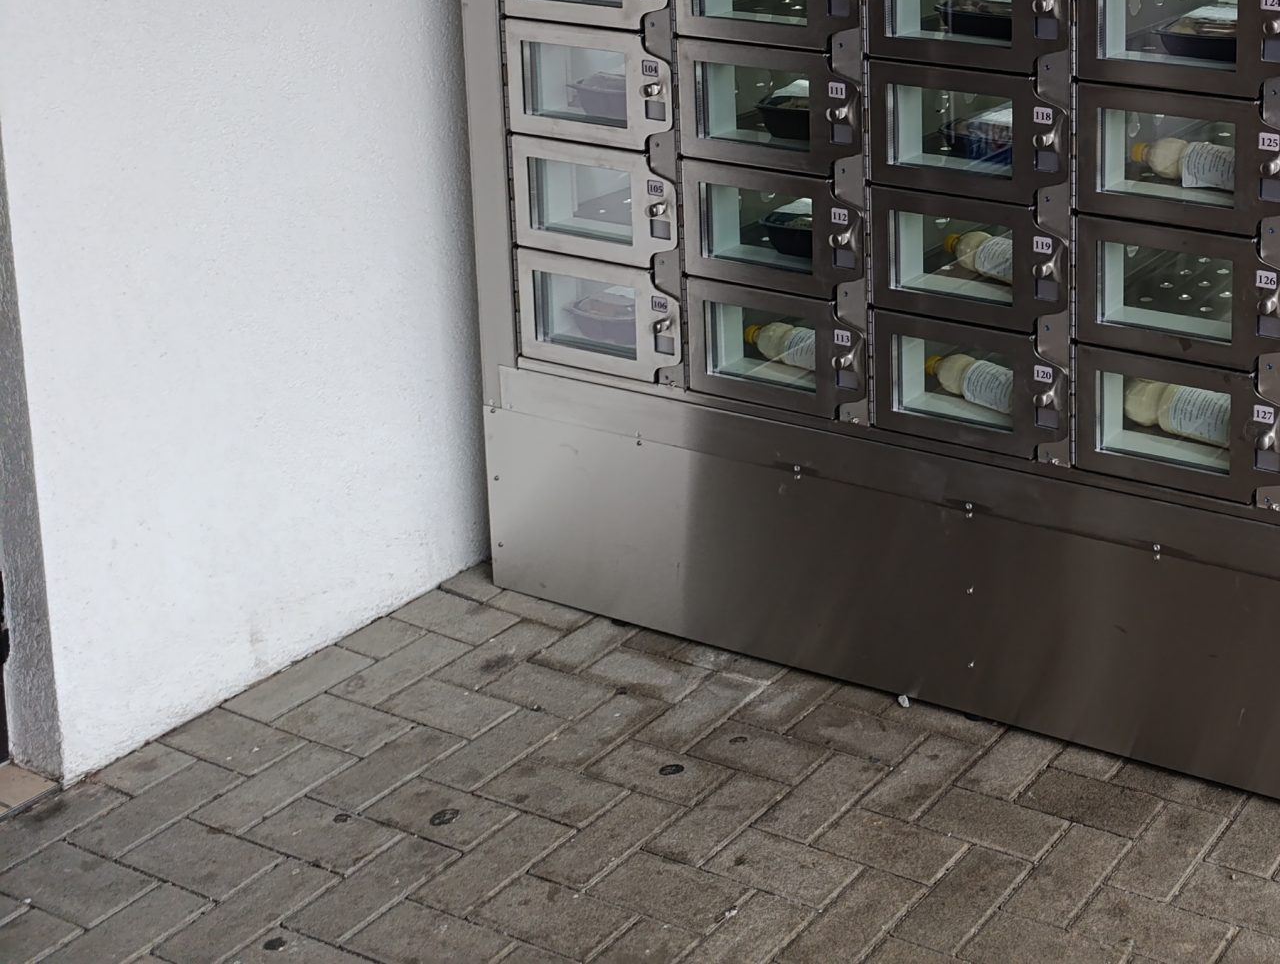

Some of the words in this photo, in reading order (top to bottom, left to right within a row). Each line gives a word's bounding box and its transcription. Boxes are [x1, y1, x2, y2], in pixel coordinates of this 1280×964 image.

[644, 64, 658, 74] 104
[830, 86, 844, 96] 111
[1034, 110, 1052, 122] 118
[1261, 138, 1278, 148] 125
[649, 184, 664, 194] 105
[832, 211, 847, 222] 112
[1034, 240, 1052, 251] 119
[1258, 275, 1276, 286] 126
[653, 300, 668, 310] 106
[835, 332, 850, 343] 113
[1035, 370, 1052, 380] 120
[1256, 410, 1273, 420] 127
